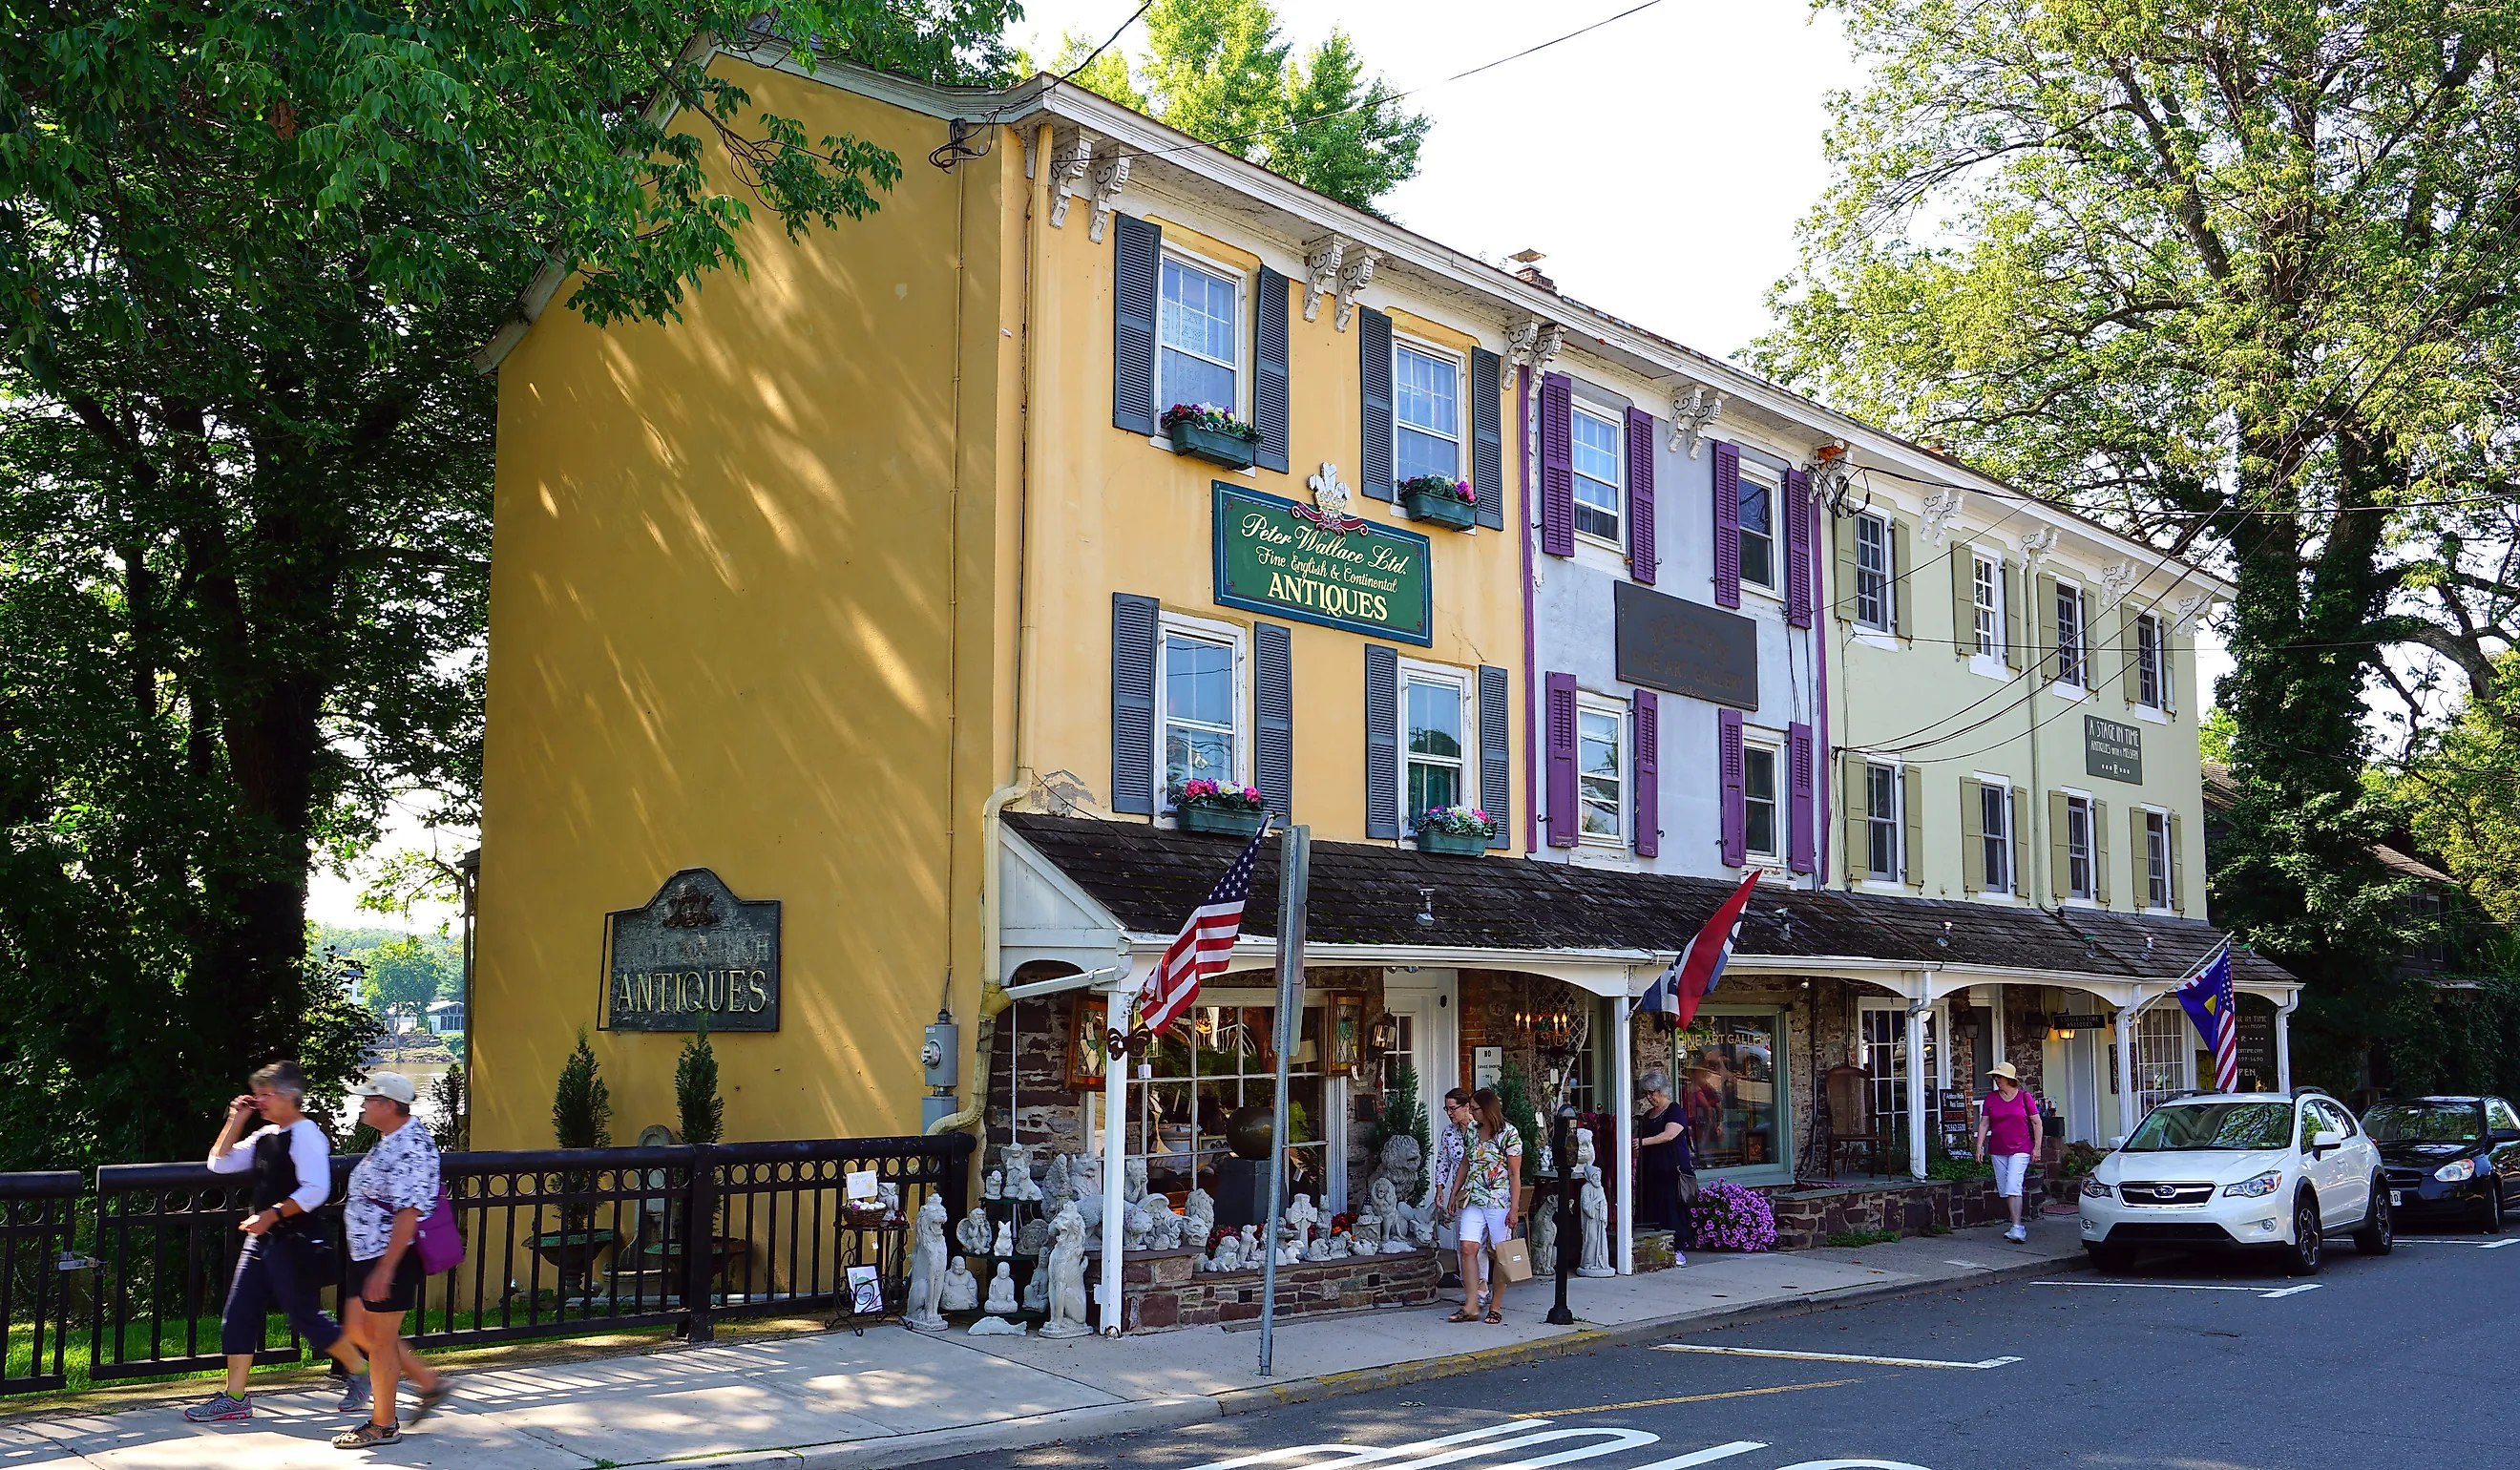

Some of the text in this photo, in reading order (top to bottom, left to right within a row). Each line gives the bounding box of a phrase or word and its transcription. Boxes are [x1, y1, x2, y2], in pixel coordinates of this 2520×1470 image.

[1241, 514, 1410, 575] Peter Wallace Ltd.
[1256, 546, 1397, 593] Fine English & Continental
[1268, 572, 1388, 620] ANTIQUES
[1631, 649, 1745, 692] FINE ART GALLERY
[2090, 720, 2139, 746] A STAGE IN TIME
[2090, 740, 2111, 755] ANTIQUES
[615, 970, 767, 1014] ANTIQUES
[1677, 1034, 1772, 1048] FINE ART GALLERY
[2238, 1068, 2257, 1077] PEN
